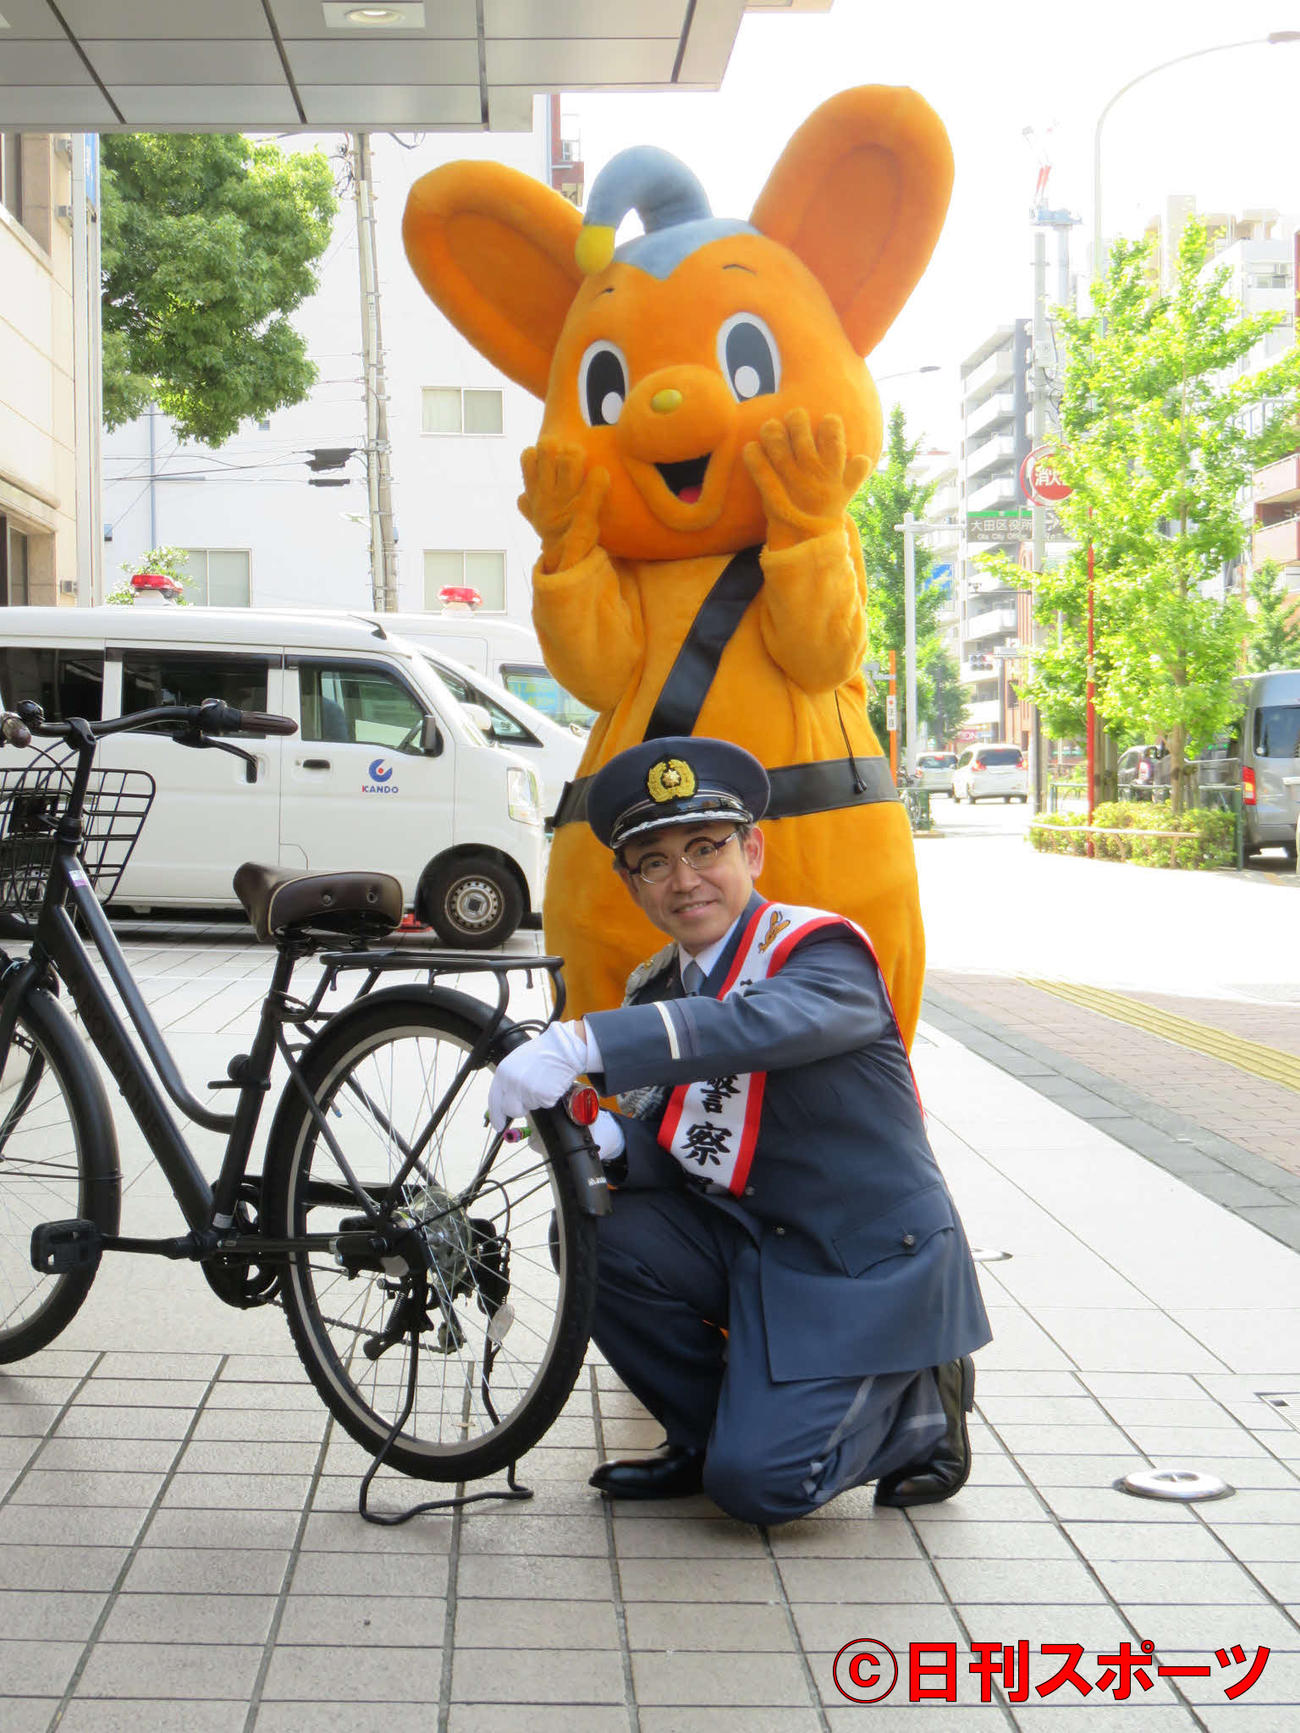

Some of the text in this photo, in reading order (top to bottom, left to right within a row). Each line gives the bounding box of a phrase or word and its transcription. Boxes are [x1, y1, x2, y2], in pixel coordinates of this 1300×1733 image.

[1035, 466, 1073, 487] 消火
[970, 519, 1033, 533] 大田区役所
[361, 785, 399, 794] KANDO
[680, 1074, 741, 1183] 警察
